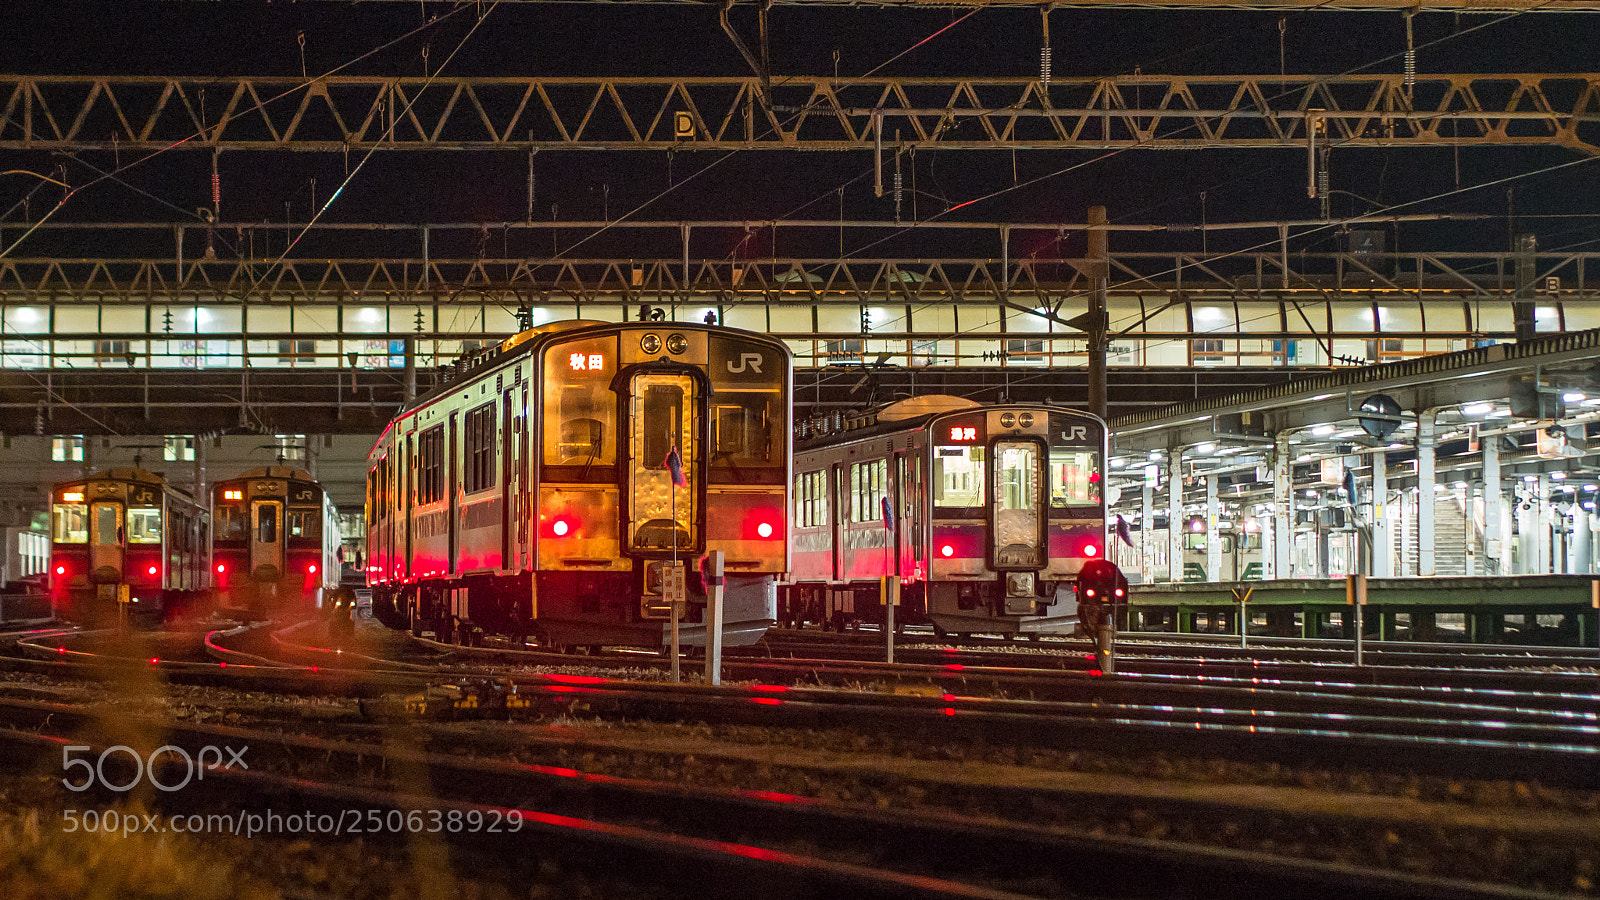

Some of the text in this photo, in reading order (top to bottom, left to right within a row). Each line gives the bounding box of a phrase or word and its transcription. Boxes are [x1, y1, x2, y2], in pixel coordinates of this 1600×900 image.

[677, 114, 693, 133] D
[1548, 279, 1558, 291] B
[569, 352, 603, 371] 秋田
[727, 352, 763, 374] JR
[1061, 425, 1087, 441] JR
[135, 491, 154, 502] JR
[296, 490, 313, 500] JR
